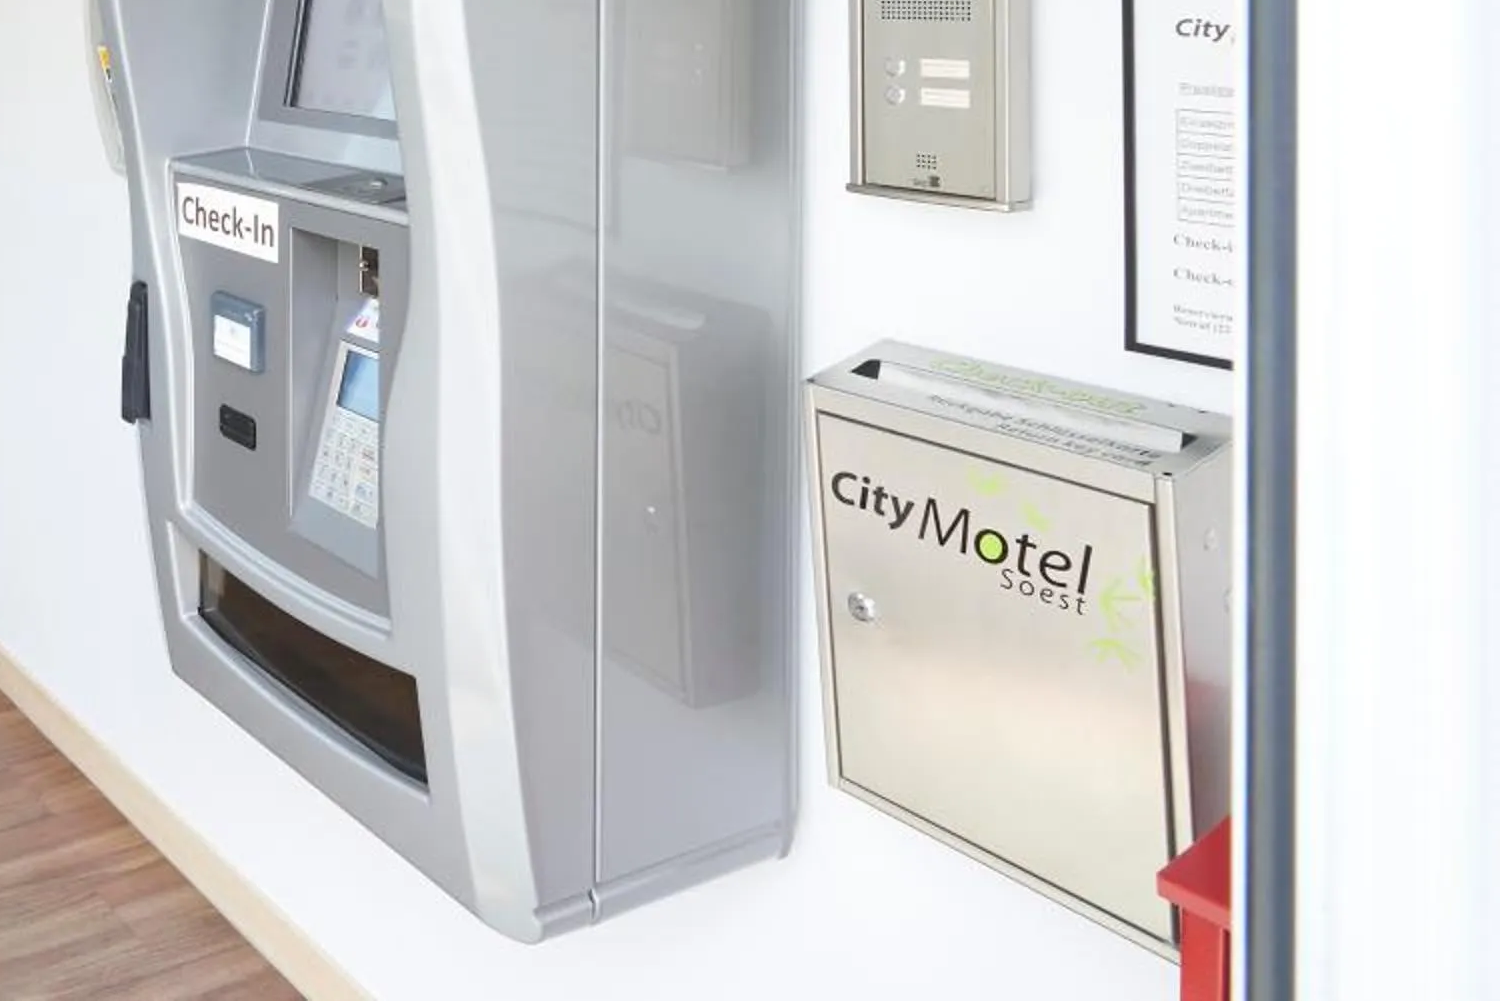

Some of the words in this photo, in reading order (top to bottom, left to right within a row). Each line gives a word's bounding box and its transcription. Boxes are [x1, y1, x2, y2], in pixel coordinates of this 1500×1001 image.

[1175, 17, 1236, 45] City
[182, 196, 275, 248] Check-In
[998, 567, 1089, 616] Soest
